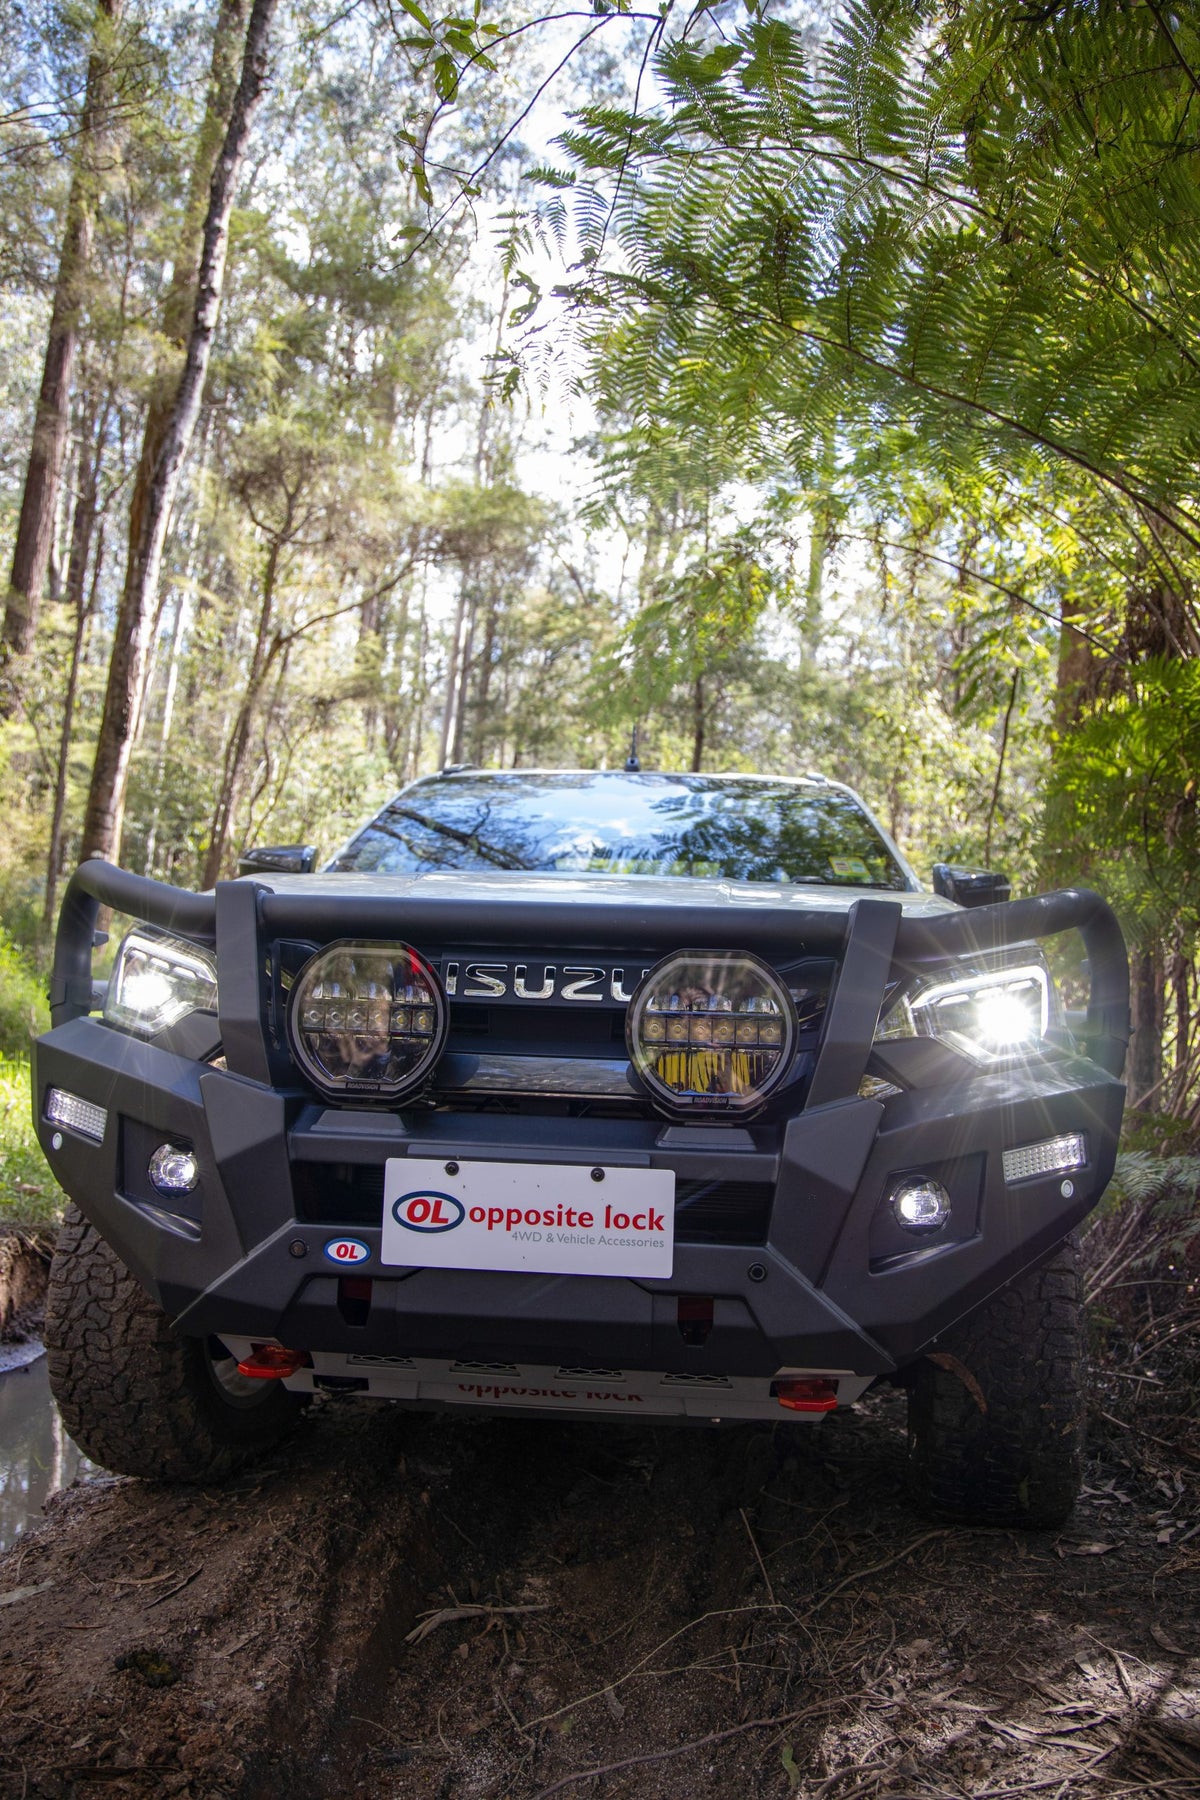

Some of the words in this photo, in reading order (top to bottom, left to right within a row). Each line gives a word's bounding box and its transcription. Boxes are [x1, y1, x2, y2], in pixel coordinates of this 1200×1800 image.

[406, 1199, 449, 1224] OL
[469, 1204, 594, 1231] opposite
[604, 1206, 665, 1231] lock
[511, 1231, 542, 1242] 4WD
[545, 1233, 555, 1243] &
[557, 1233, 596, 1245] Vehicle
[597, 1235, 665, 1248] Accessories
[336, 1244, 358, 1259] OL
